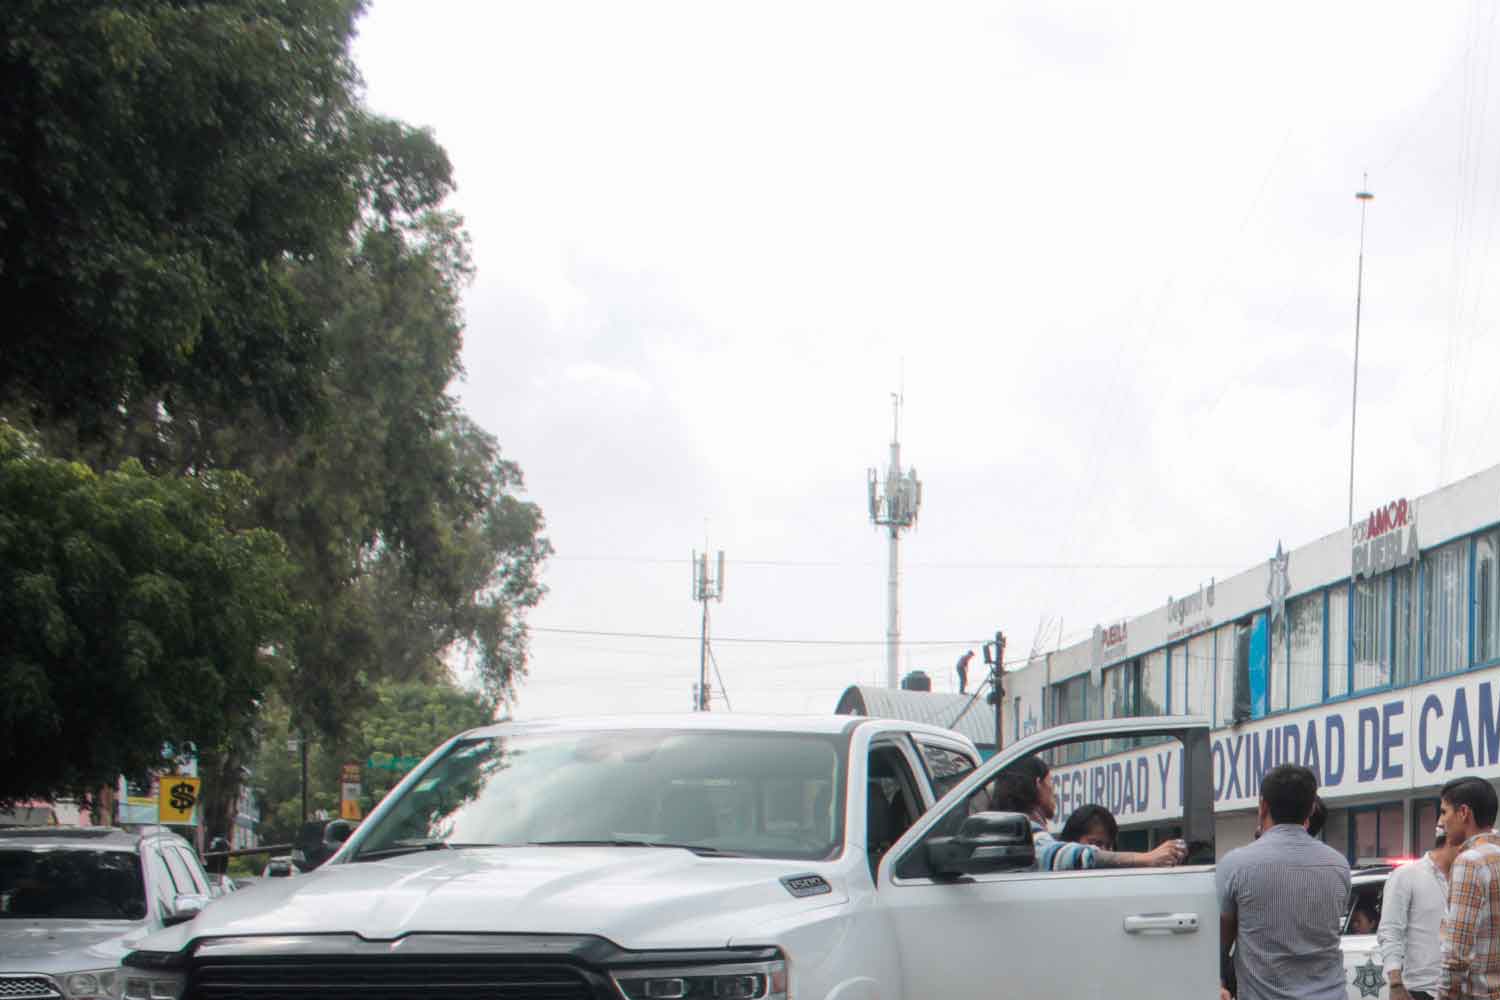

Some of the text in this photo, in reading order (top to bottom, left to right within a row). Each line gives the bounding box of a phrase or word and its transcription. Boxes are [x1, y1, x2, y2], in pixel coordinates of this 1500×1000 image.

[1367, 498, 1408, 540] AMOR
[1051, 757, 1149, 824] SEGURIDAD
[1158, 752, 1172, 809] Y
[1358, 701, 1404, 782] DE
